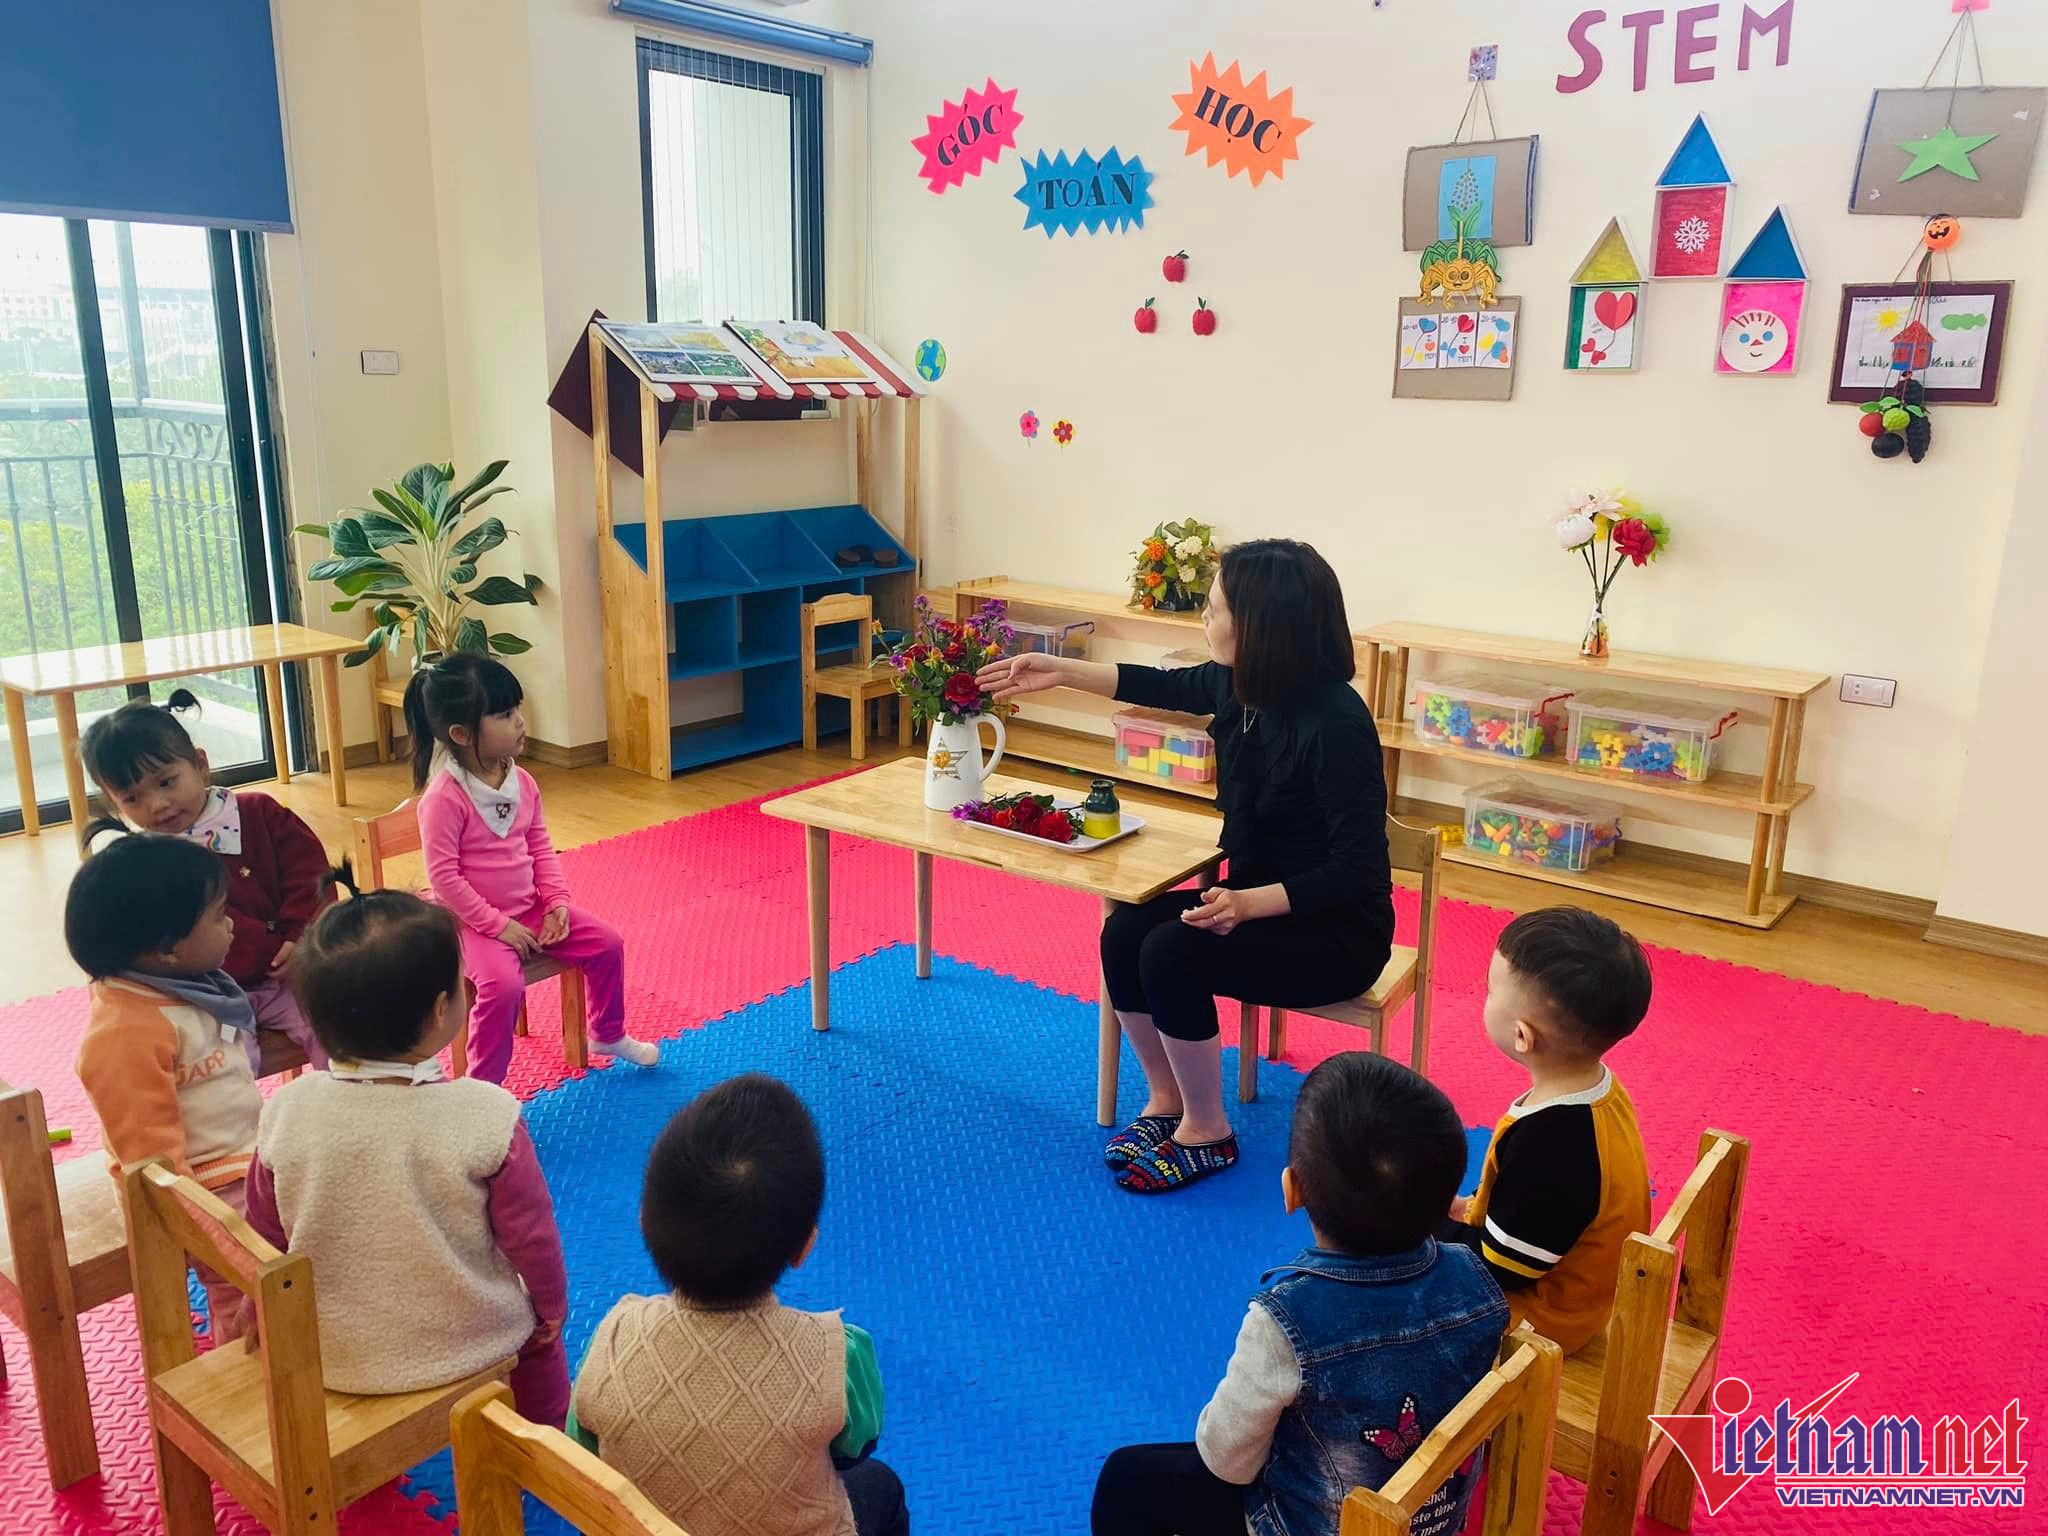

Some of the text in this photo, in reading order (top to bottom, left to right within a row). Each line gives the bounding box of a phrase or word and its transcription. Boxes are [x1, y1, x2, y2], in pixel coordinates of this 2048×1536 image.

[1555, 0, 1795, 94] STEM
[936, 103, 1004, 167] GÓC
[1193, 85, 1282, 154] HỌC
[1037, 162, 1136, 211] TOÁN
